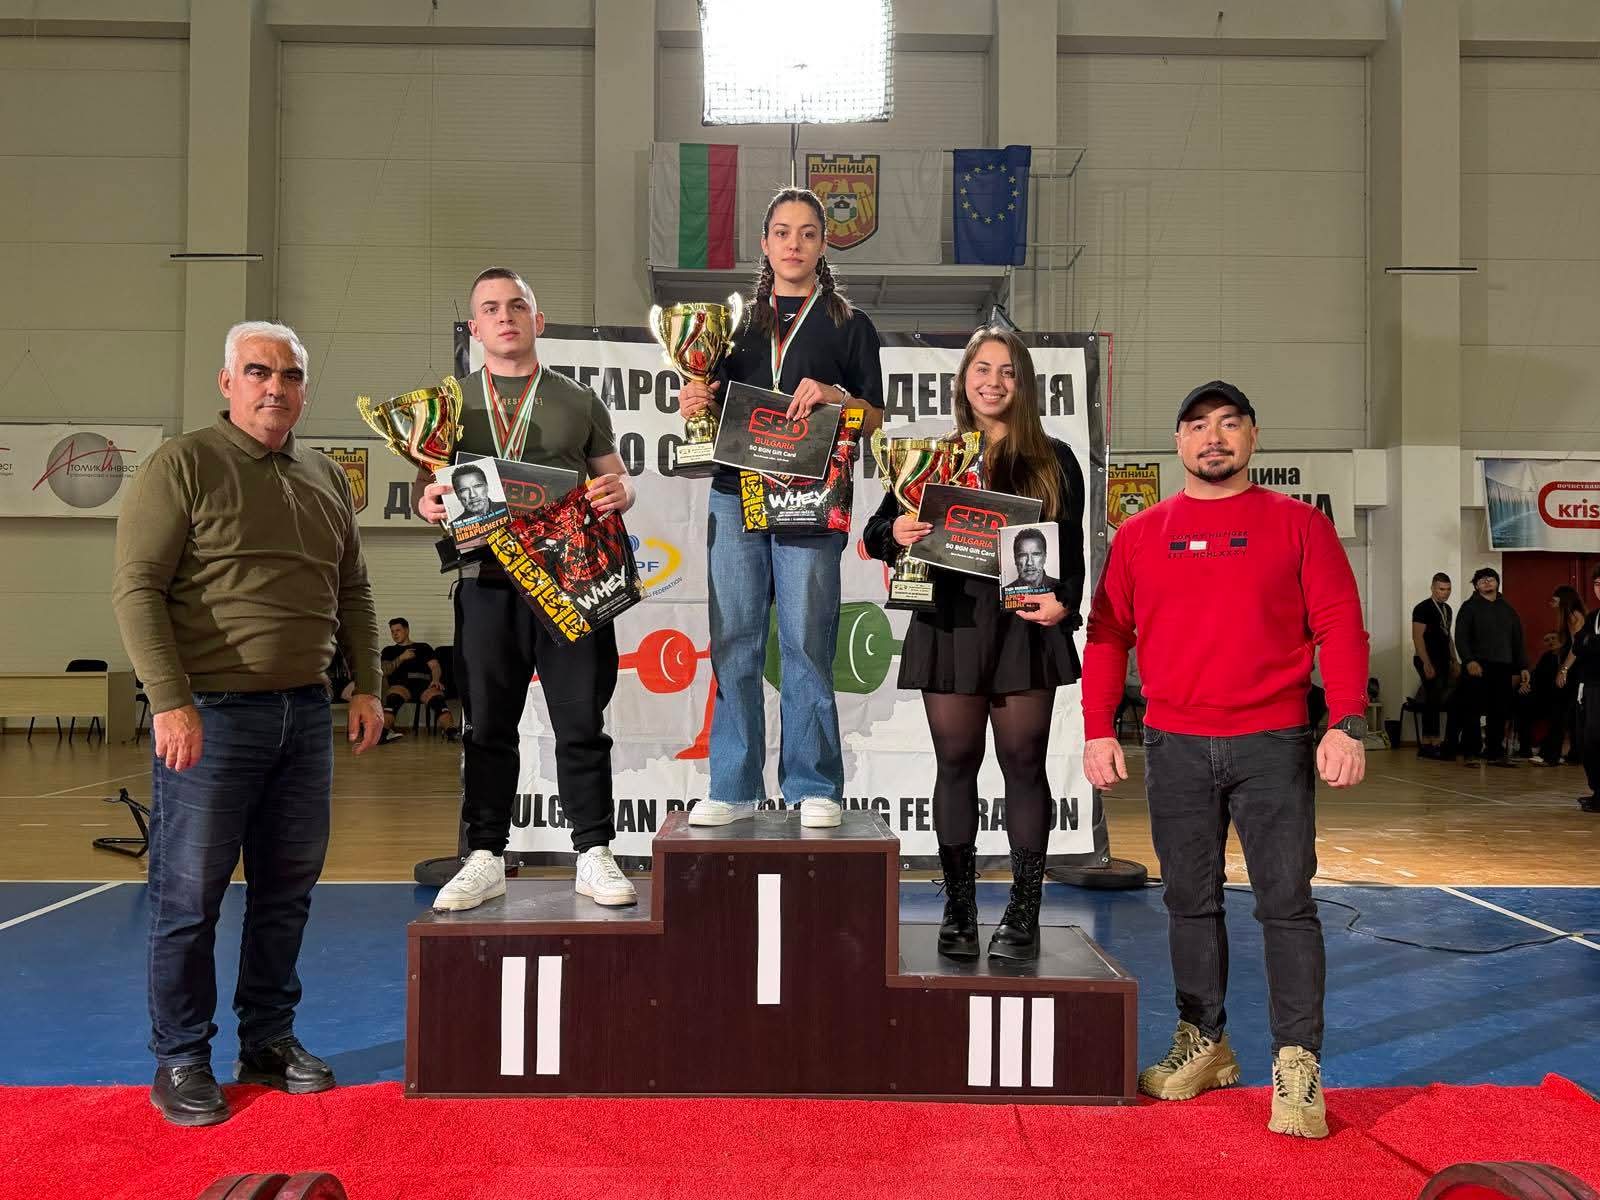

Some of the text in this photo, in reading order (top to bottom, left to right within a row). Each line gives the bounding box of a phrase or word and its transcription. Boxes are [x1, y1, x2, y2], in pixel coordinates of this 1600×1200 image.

[810, 163, 874, 175] ДУПНИЦА
[755, 437, 796, 450] BULGARIA
[768, 488, 831, 509] WHEY
[951, 535, 993, 549] BULGARIA
[954, 544, 969, 552] BGN
[577, 565, 626, 610] WHEY
[652, 576, 683, 597] FEDERATION
